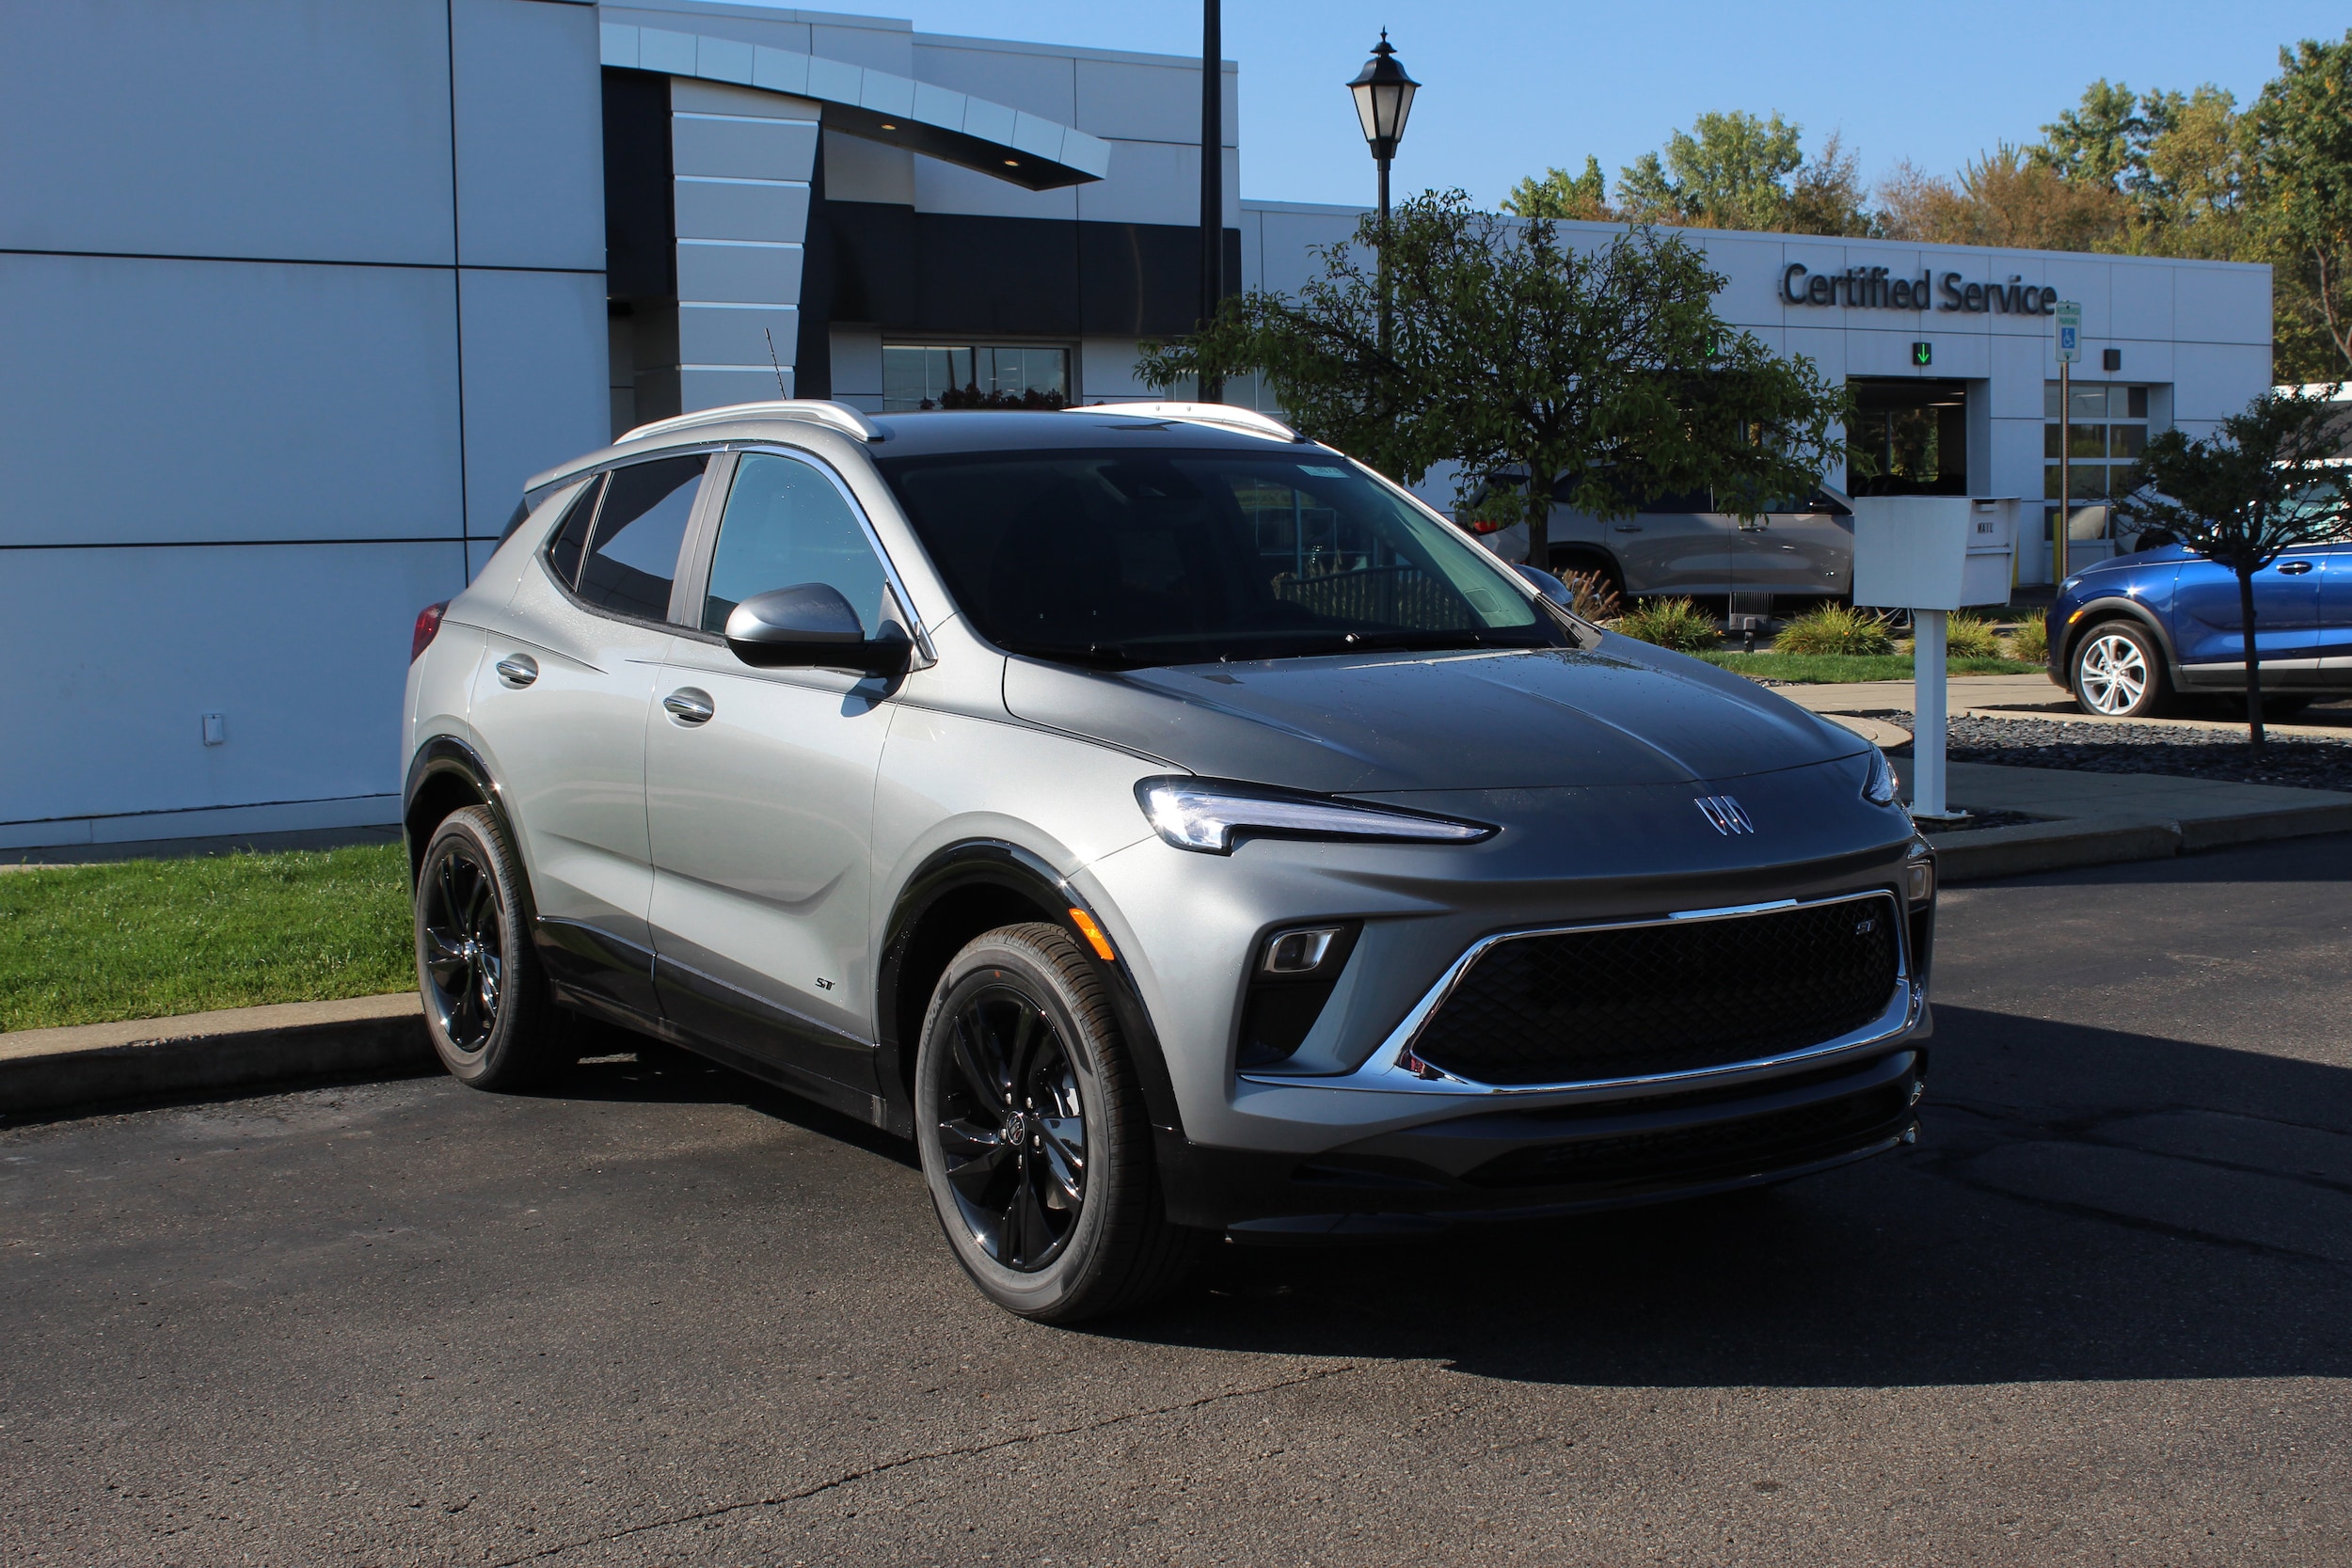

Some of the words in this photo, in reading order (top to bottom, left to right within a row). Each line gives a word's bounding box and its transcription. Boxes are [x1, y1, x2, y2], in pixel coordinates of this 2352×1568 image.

[1780, 262, 1931, 309] Certified
[1939, 271, 2058, 315] Service
[1978, 521, 1994, 534] MAIL
[815, 977, 835, 990] ST
